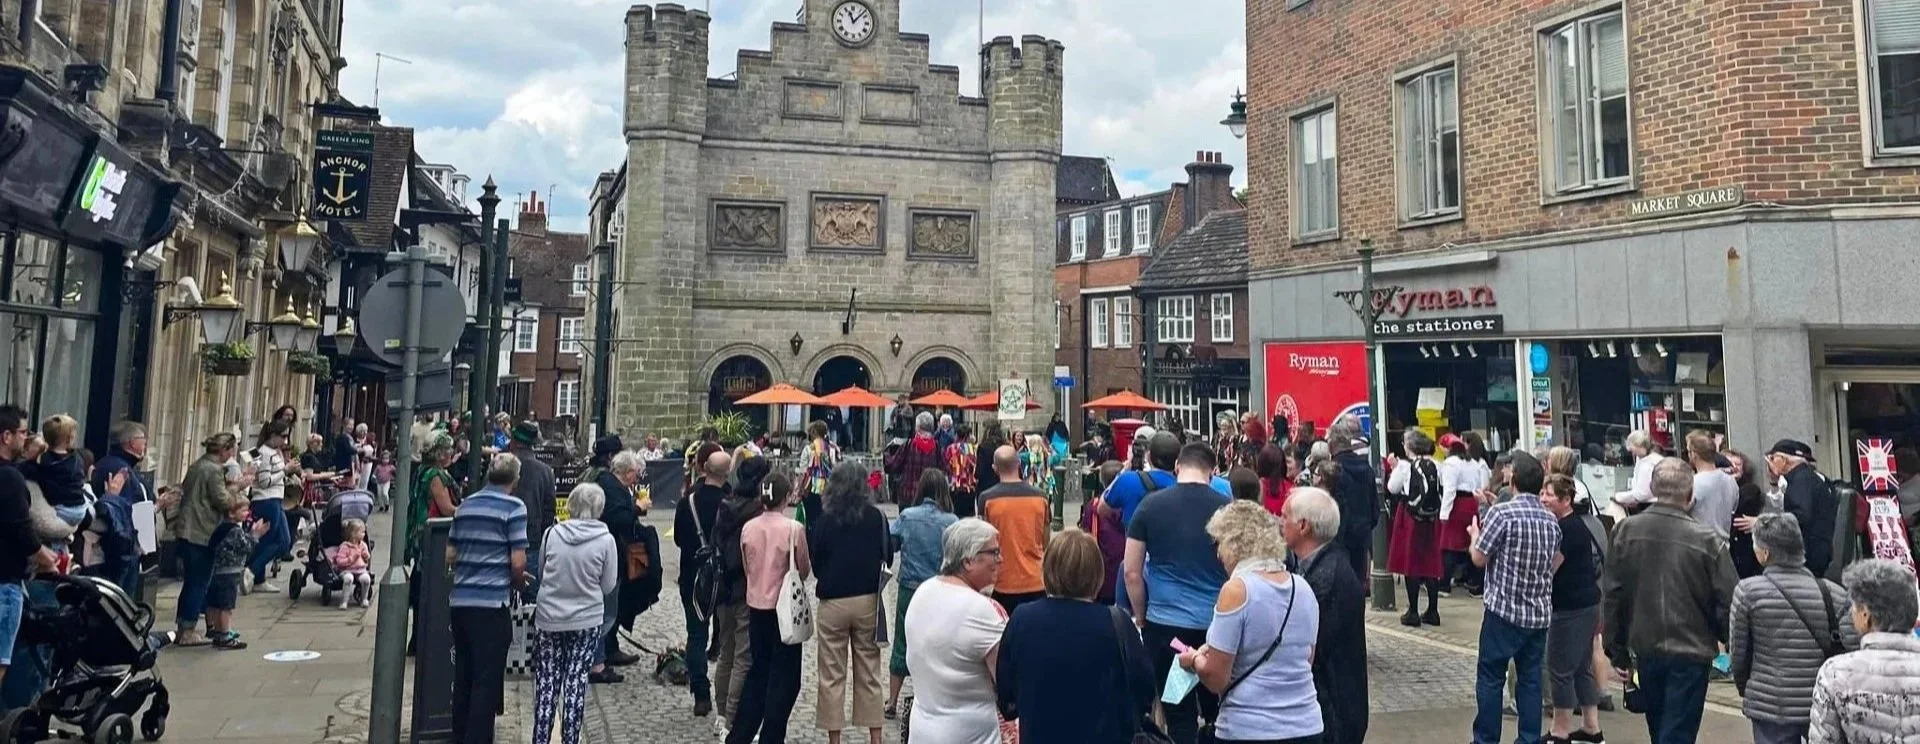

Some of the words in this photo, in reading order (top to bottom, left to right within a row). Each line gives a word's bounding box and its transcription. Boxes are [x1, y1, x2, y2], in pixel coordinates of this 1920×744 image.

[321, 135, 349, 143] GREENE
[351, 137, 370, 145] KING
[320, 156, 367, 172] ANCHOR
[316, 202, 361, 217] HOTEL
[1631, 196, 1681, 215] MARKET
[1687, 188, 1735, 207] SQUARE
[1374, 321, 1400, 334] the
[1406, 318, 1496, 334] stationer
[1288, 352, 1340, 371] Ryman
